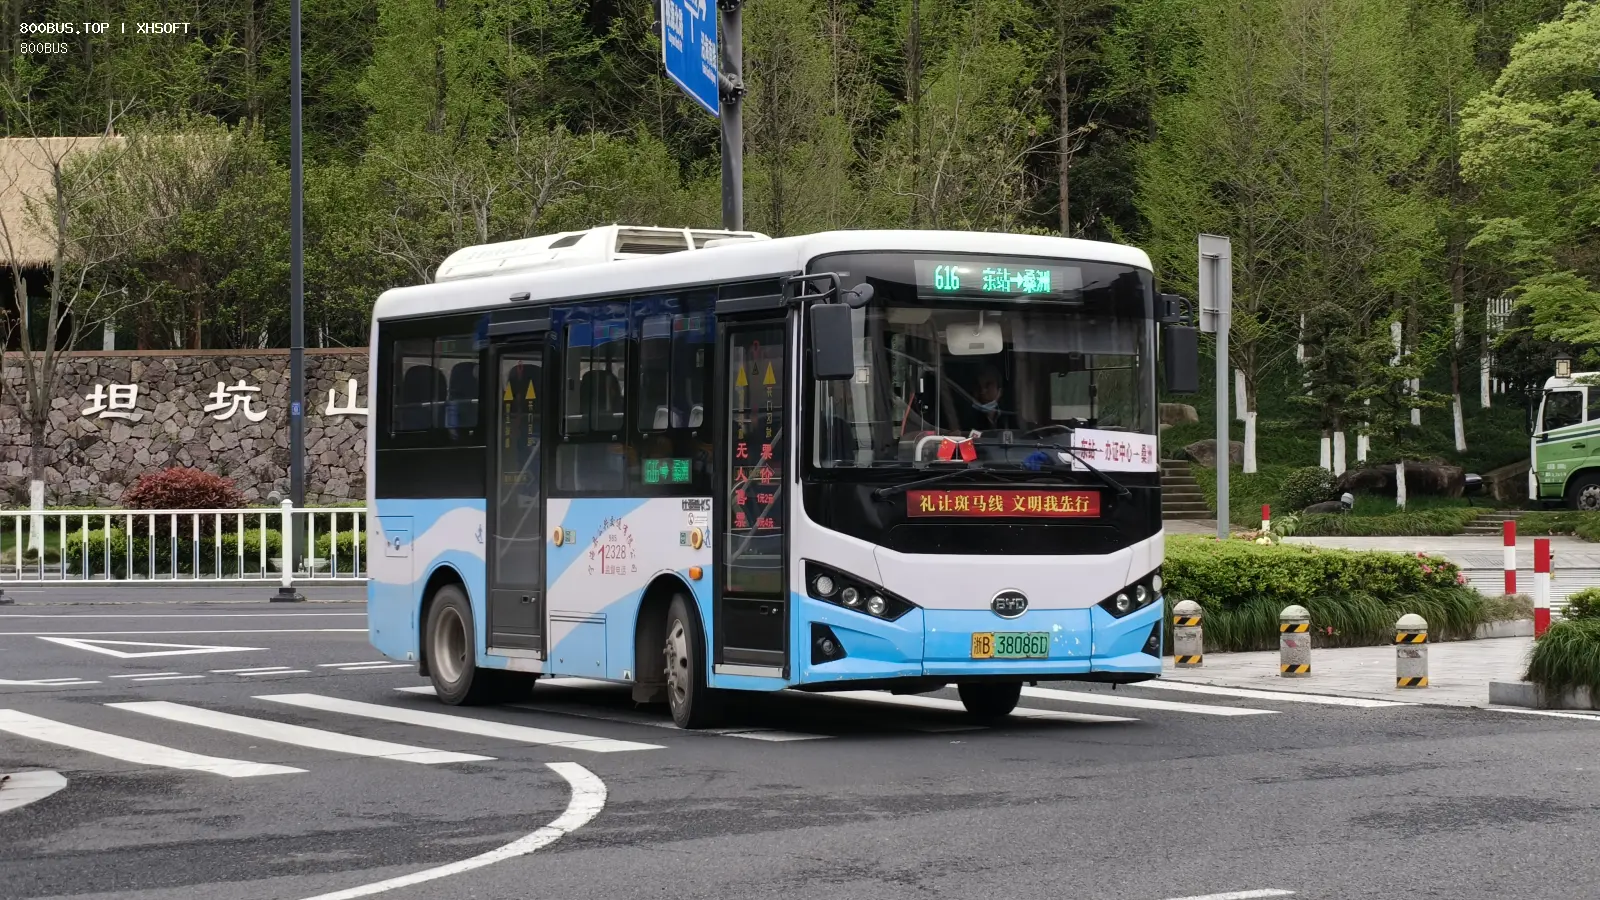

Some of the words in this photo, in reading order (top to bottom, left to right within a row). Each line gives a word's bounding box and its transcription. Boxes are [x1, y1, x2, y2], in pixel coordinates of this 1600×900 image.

[934, 264, 960, 291] 616
[919, 494, 1004, 512] 礼让斑马线
[1011, 495, 1090, 512] 文明我先行
[995, 597, 1025, 610] BYD
